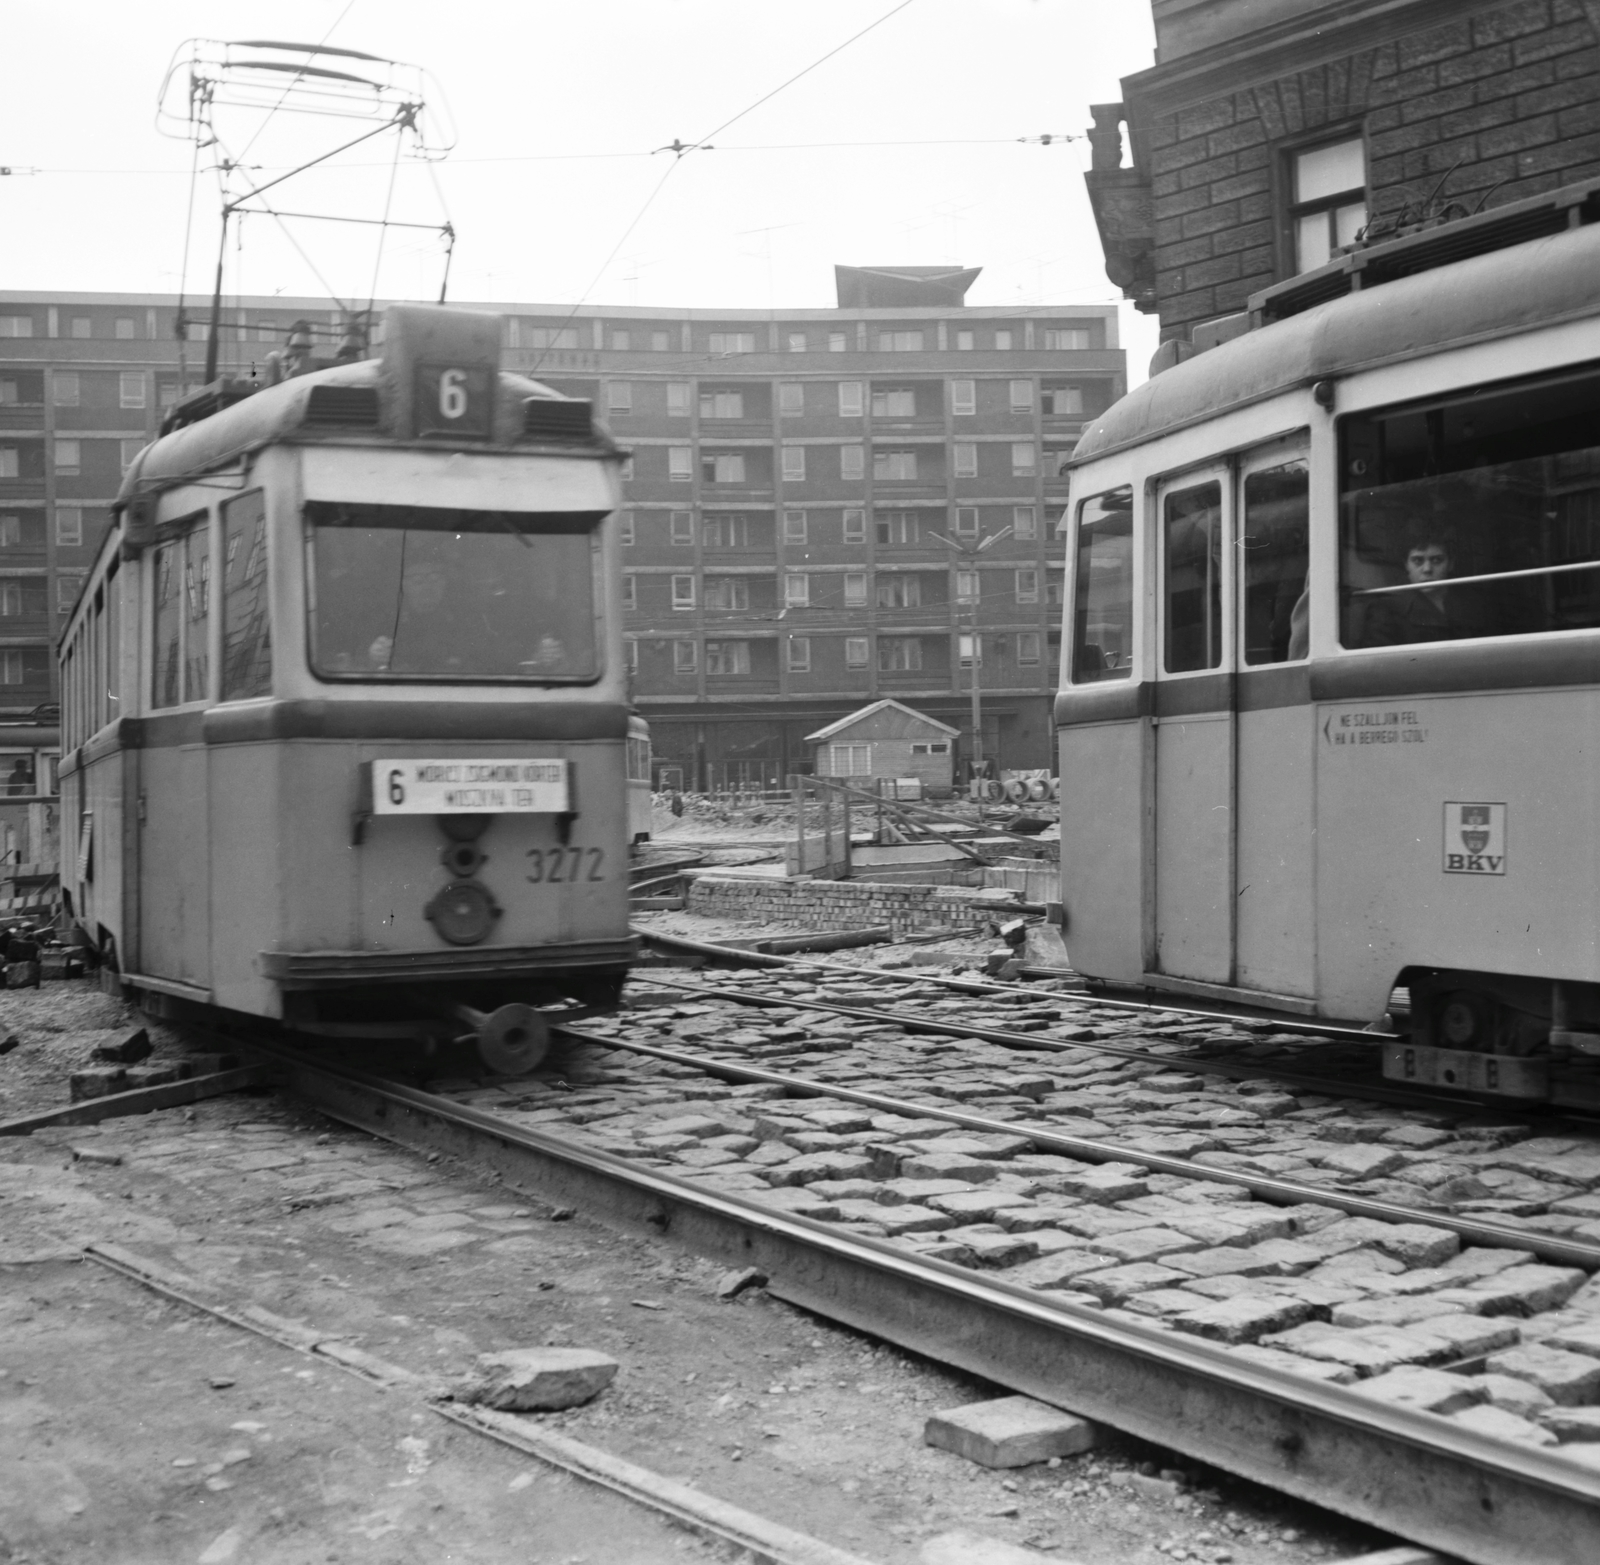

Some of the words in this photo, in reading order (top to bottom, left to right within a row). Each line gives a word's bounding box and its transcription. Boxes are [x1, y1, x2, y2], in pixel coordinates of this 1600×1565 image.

[440, 368, 467, 419] 6
[1401, 710, 1419, 725] FEL
[389, 769, 404, 805] 6
[525, 846, 605, 884] 3272
[1447, 853, 1503, 872] BKV
